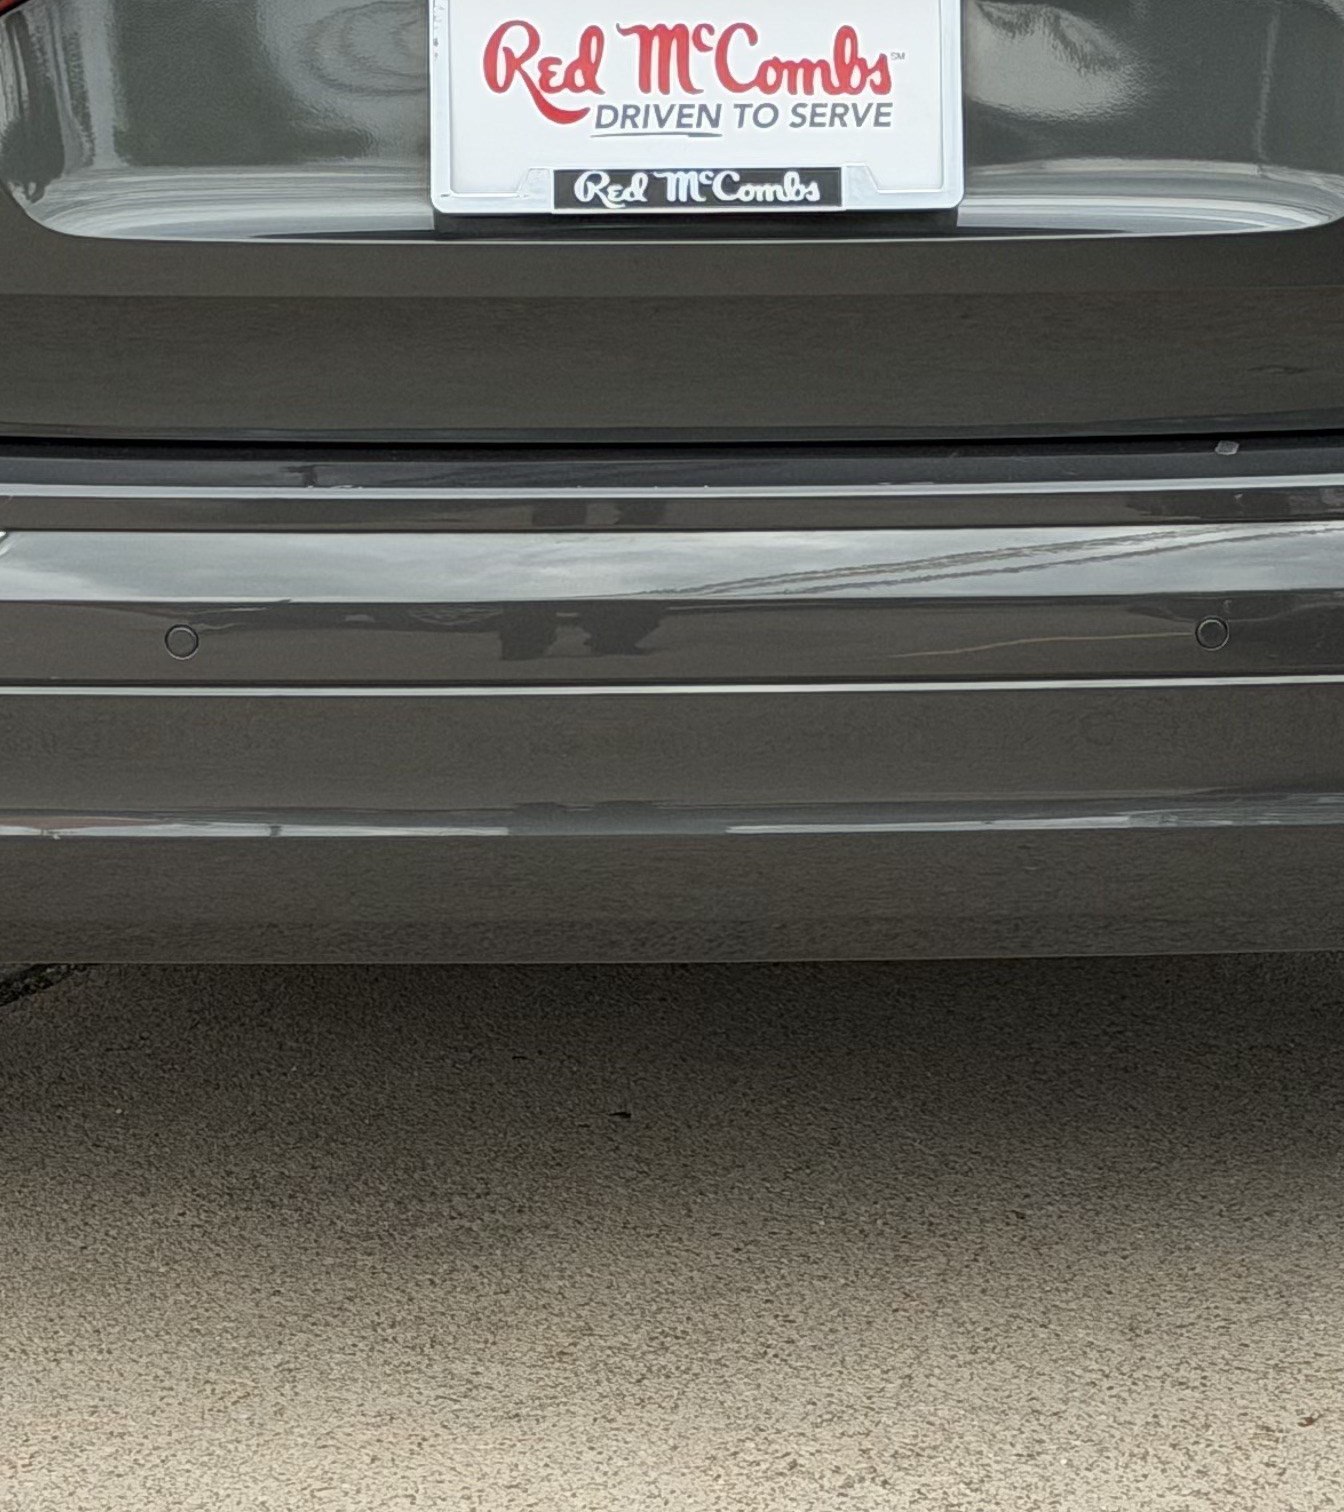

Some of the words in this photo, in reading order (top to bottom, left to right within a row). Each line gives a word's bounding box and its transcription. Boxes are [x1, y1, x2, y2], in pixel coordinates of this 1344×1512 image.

[483, 20, 606, 125] Red
[615, 22, 893, 96] McCombs
[595, 102, 722, 130] DRIVEN
[732, 102, 778, 129] TO
[788, 101, 894, 128] SERVE
[573, 170, 646, 208] Red
[653, 170, 821, 204] McCombs
